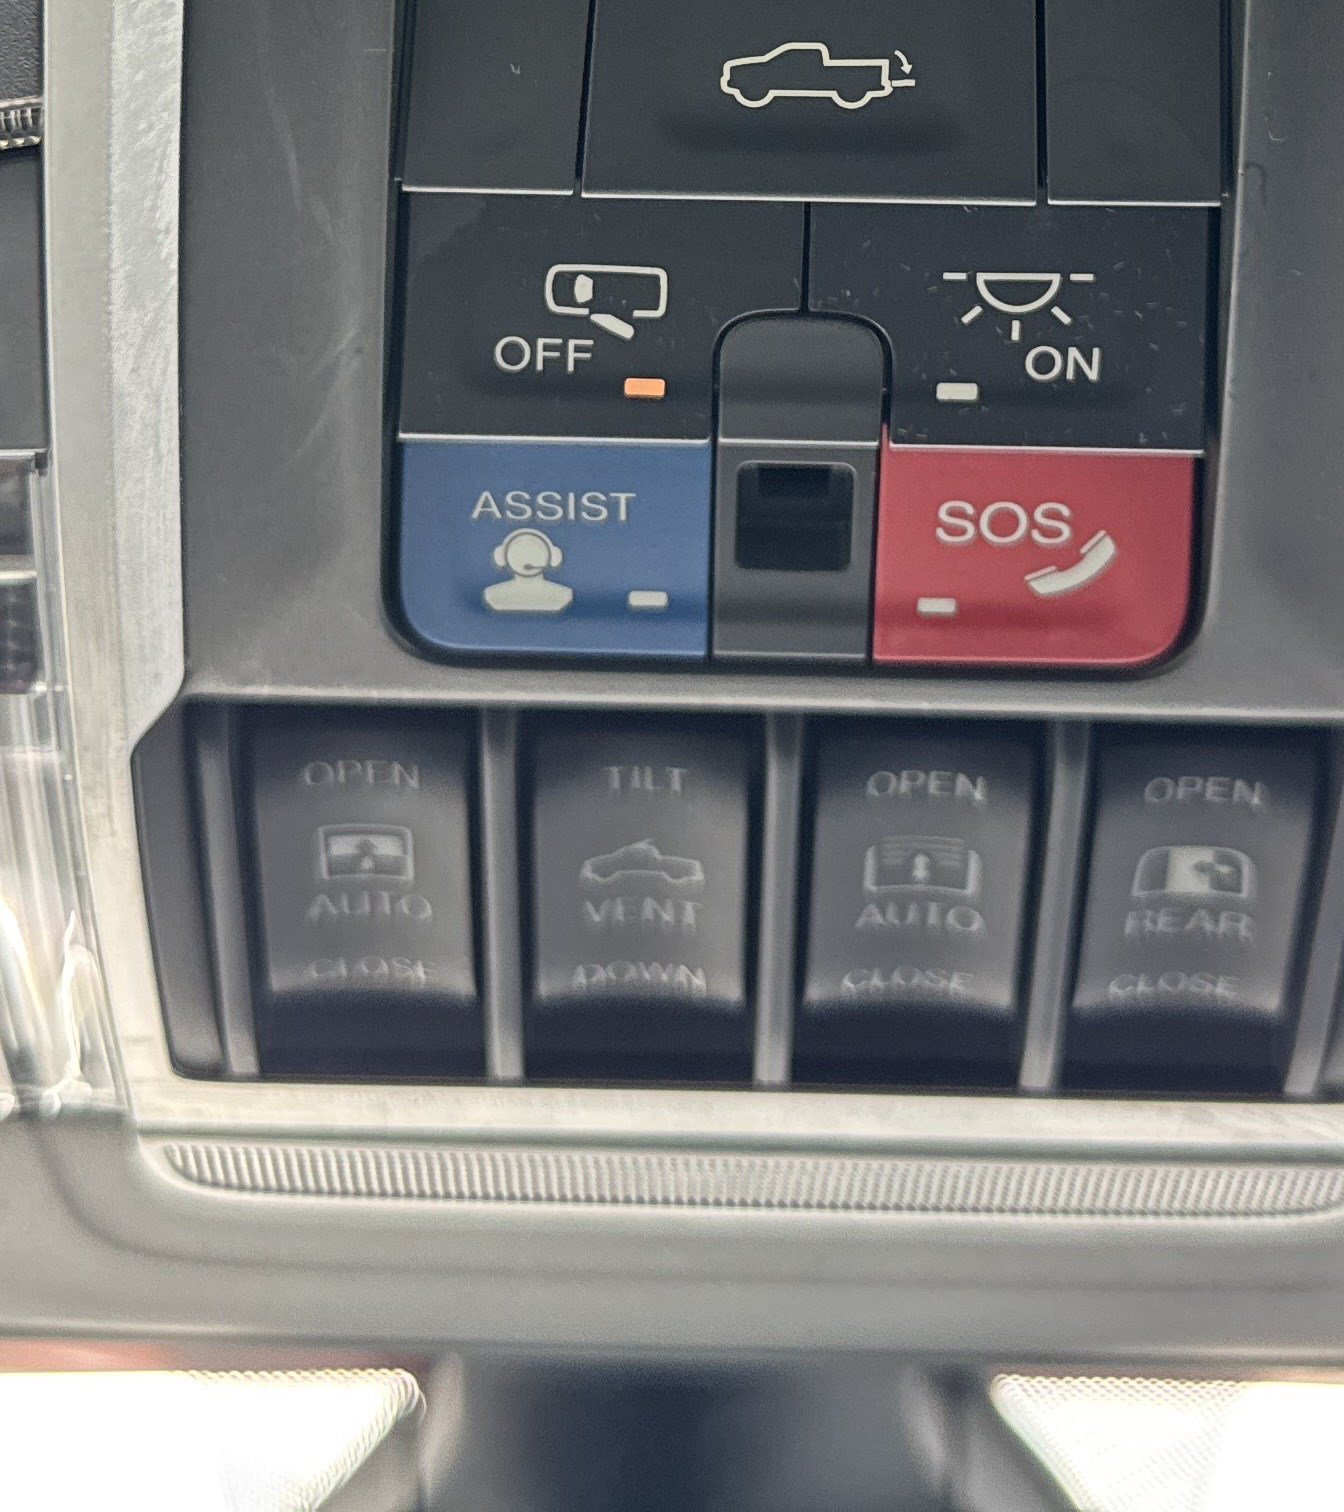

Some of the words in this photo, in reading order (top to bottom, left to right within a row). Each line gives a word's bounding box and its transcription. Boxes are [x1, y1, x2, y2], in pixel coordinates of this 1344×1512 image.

[493, 337, 595, 373] OFF
[1024, 346, 1101, 383] ON
[470, 491, 637, 524] ASSIST
[935, 500, 1074, 545] SOS
[300, 759, 422, 789] OPEN
[605, 765, 689, 793] TILT
[866, 769, 988, 804] OPEN
[1143, 775, 1264, 807] OPEN
[306, 890, 434, 922] AUTO
[581, 896, 704, 929] VENT
[855, 902, 987, 933] AUTO
[1122, 906, 1255, 939] REAR
[840, 965, 976, 994] CLOSE
[1108, 970, 1238, 998] CLOSE
